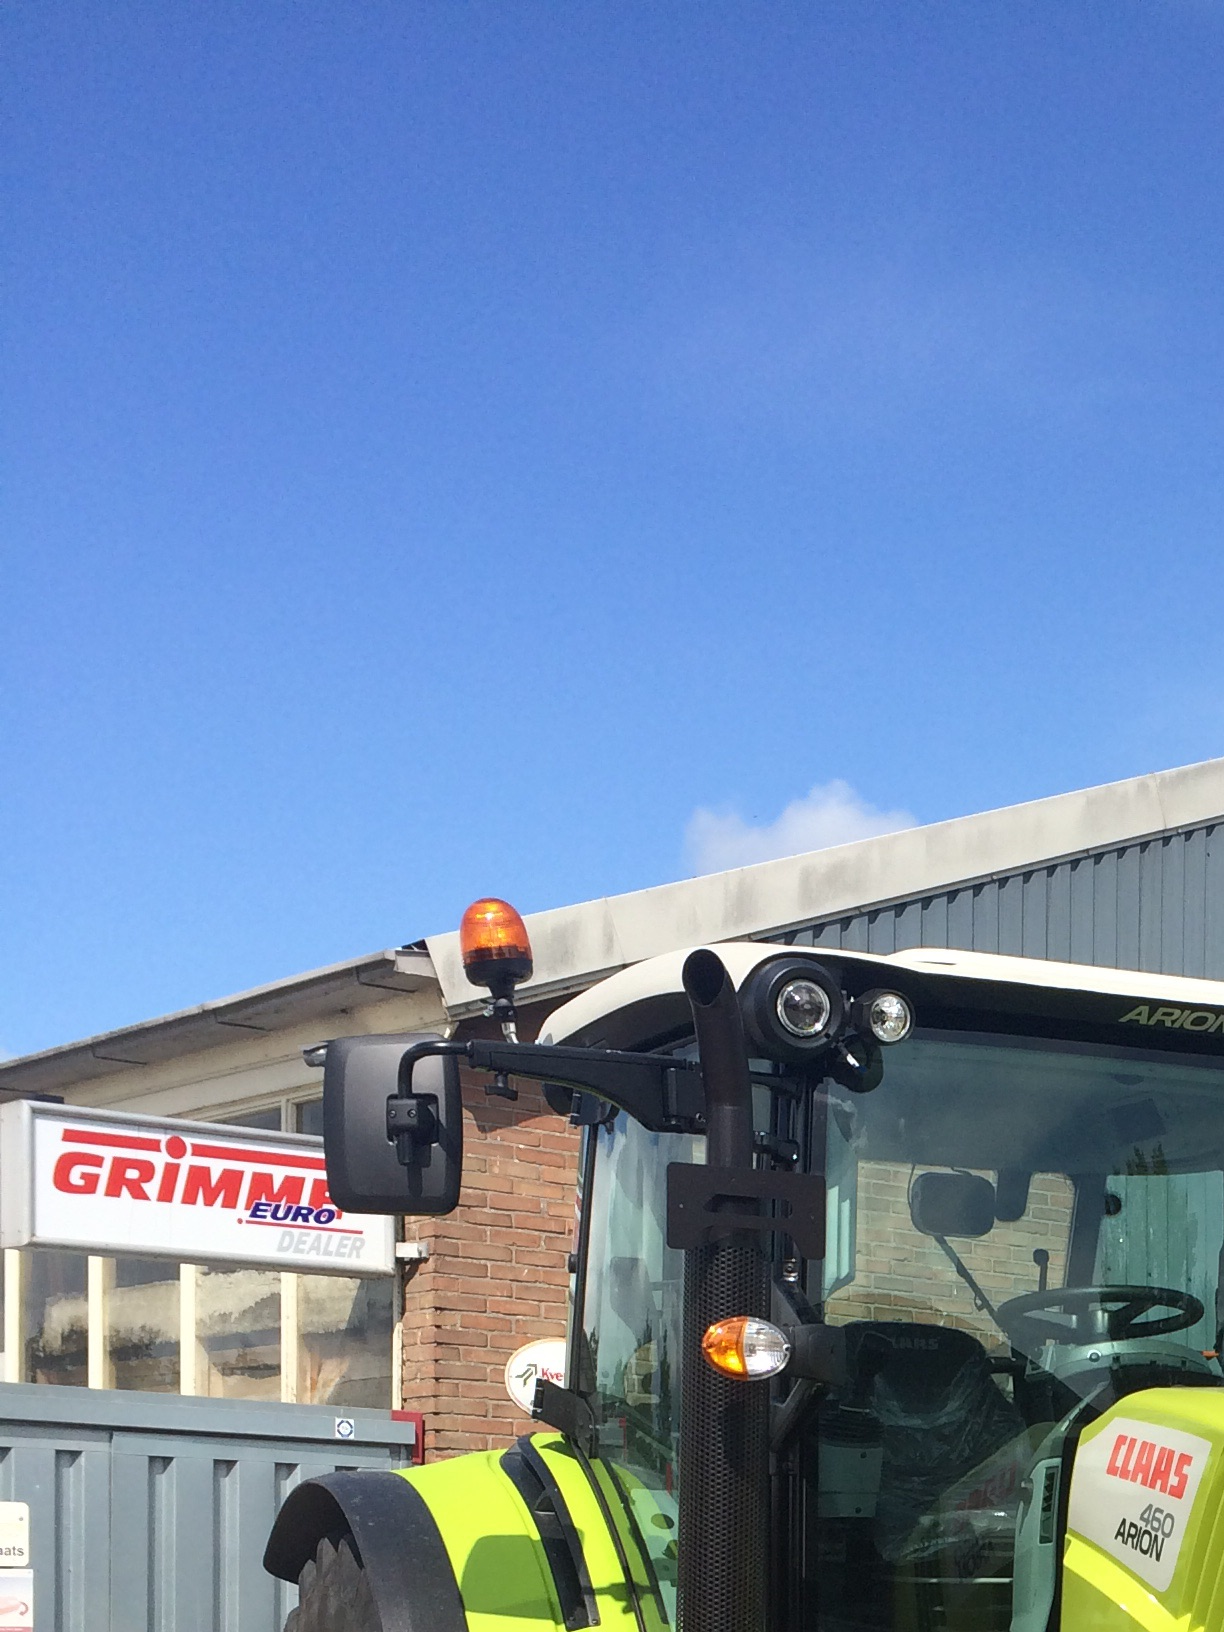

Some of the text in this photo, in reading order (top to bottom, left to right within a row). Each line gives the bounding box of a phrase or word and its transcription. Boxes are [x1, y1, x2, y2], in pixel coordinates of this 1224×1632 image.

[249, 1202, 336, 1225] EURO
[276, 1230, 366, 1260] DEALER
[1106, 1434, 1193, 1500] CLAAS
[1139, 1503, 1175, 1539] 460
[1114, 1518, 1166, 1563] ARION
